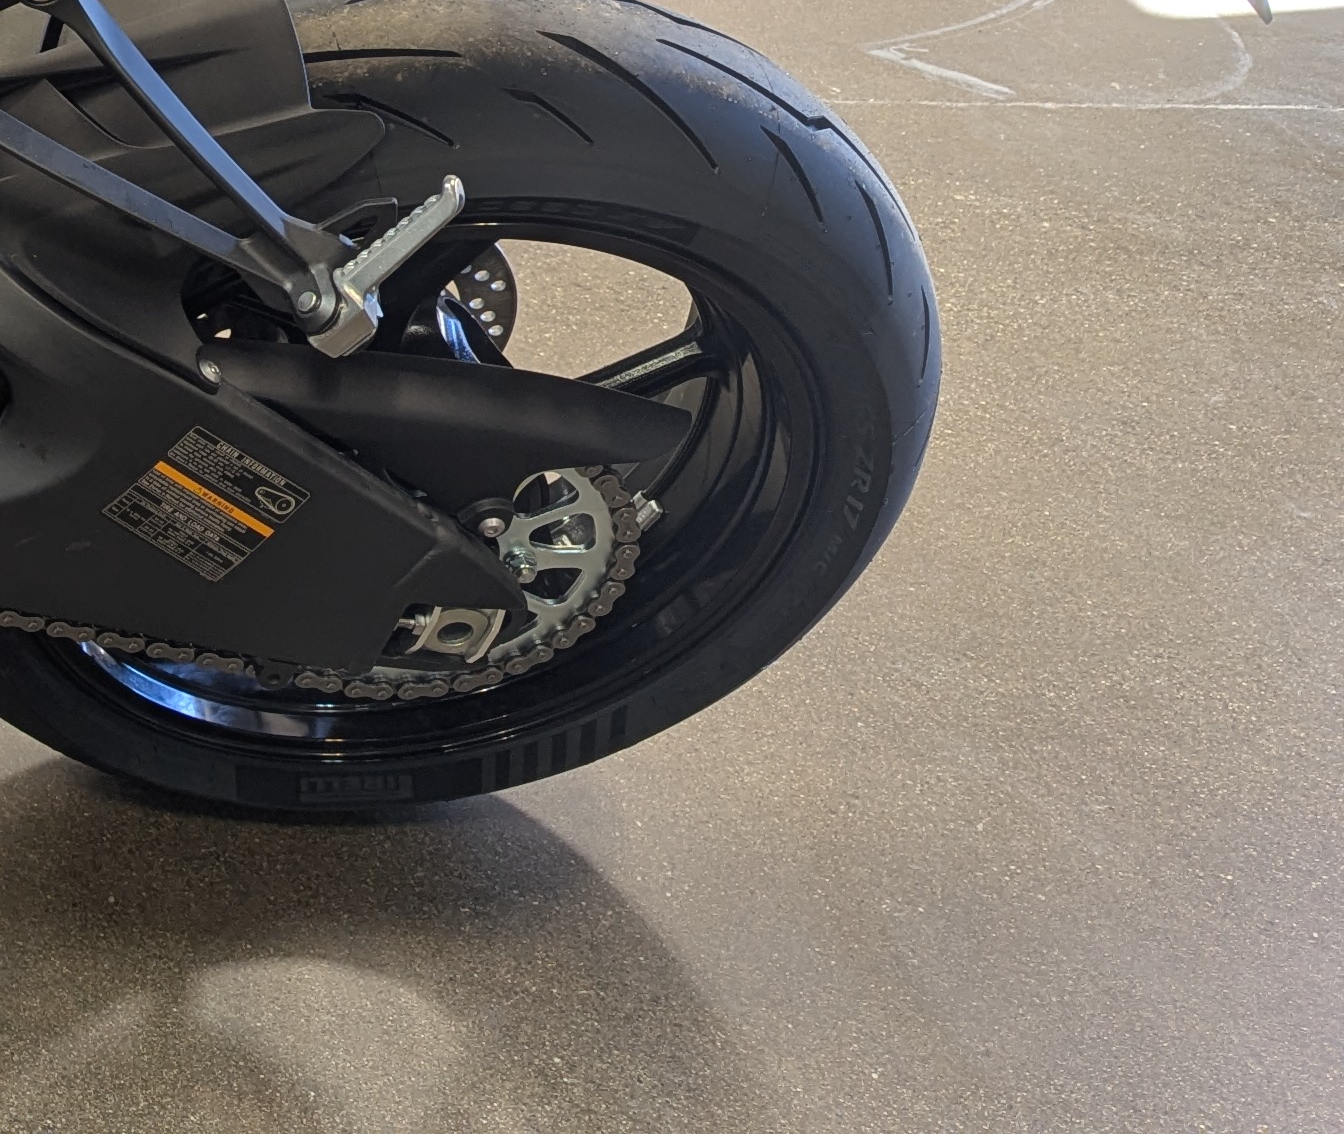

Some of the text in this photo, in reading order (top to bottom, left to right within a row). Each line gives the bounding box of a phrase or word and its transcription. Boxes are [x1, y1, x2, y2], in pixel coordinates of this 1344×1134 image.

[216, 441, 286, 487] CHAIN INFORMATION
[201, 489, 236, 515] WARNING
[173, 510, 188, 522] AND
[187, 517, 205, 533] LOAD
[205, 528, 221, 542] DATA
